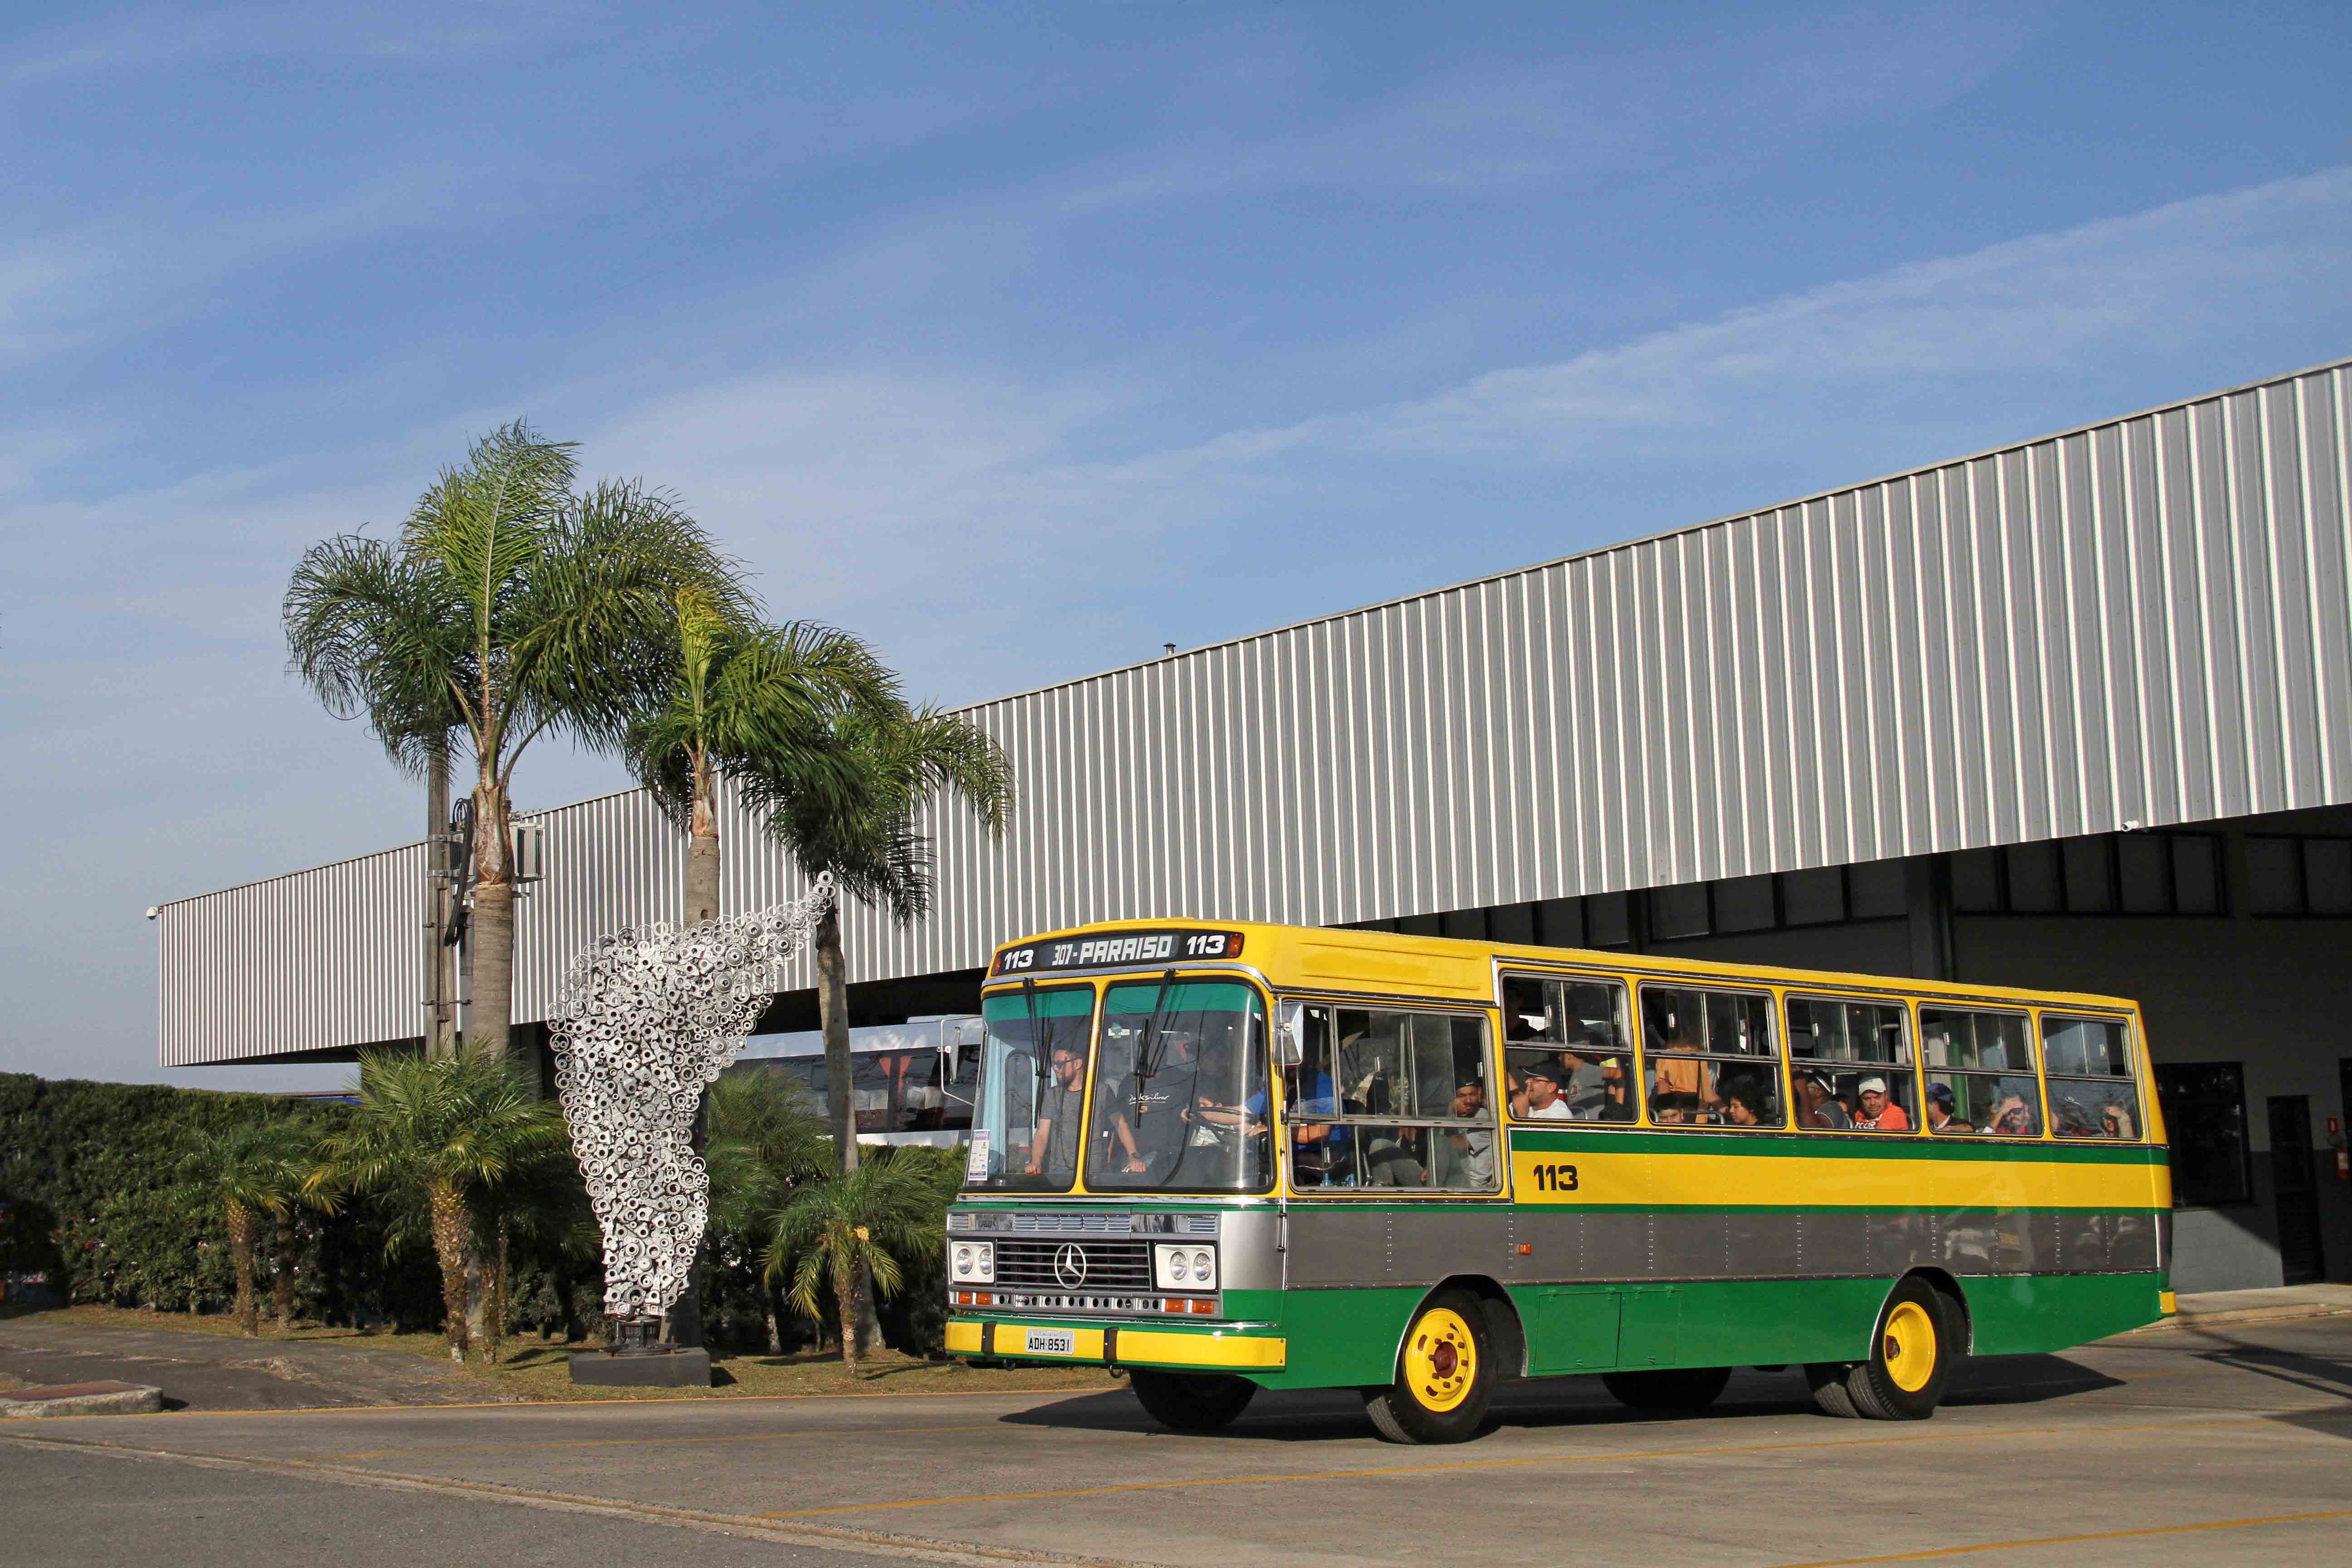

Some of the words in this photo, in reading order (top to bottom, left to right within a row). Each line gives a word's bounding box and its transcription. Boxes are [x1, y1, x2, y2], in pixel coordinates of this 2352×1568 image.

[1186, 935, 1225, 955] 113
[1004, 949, 1034, 970] 113
[1534, 1165, 1578, 1191] 113
